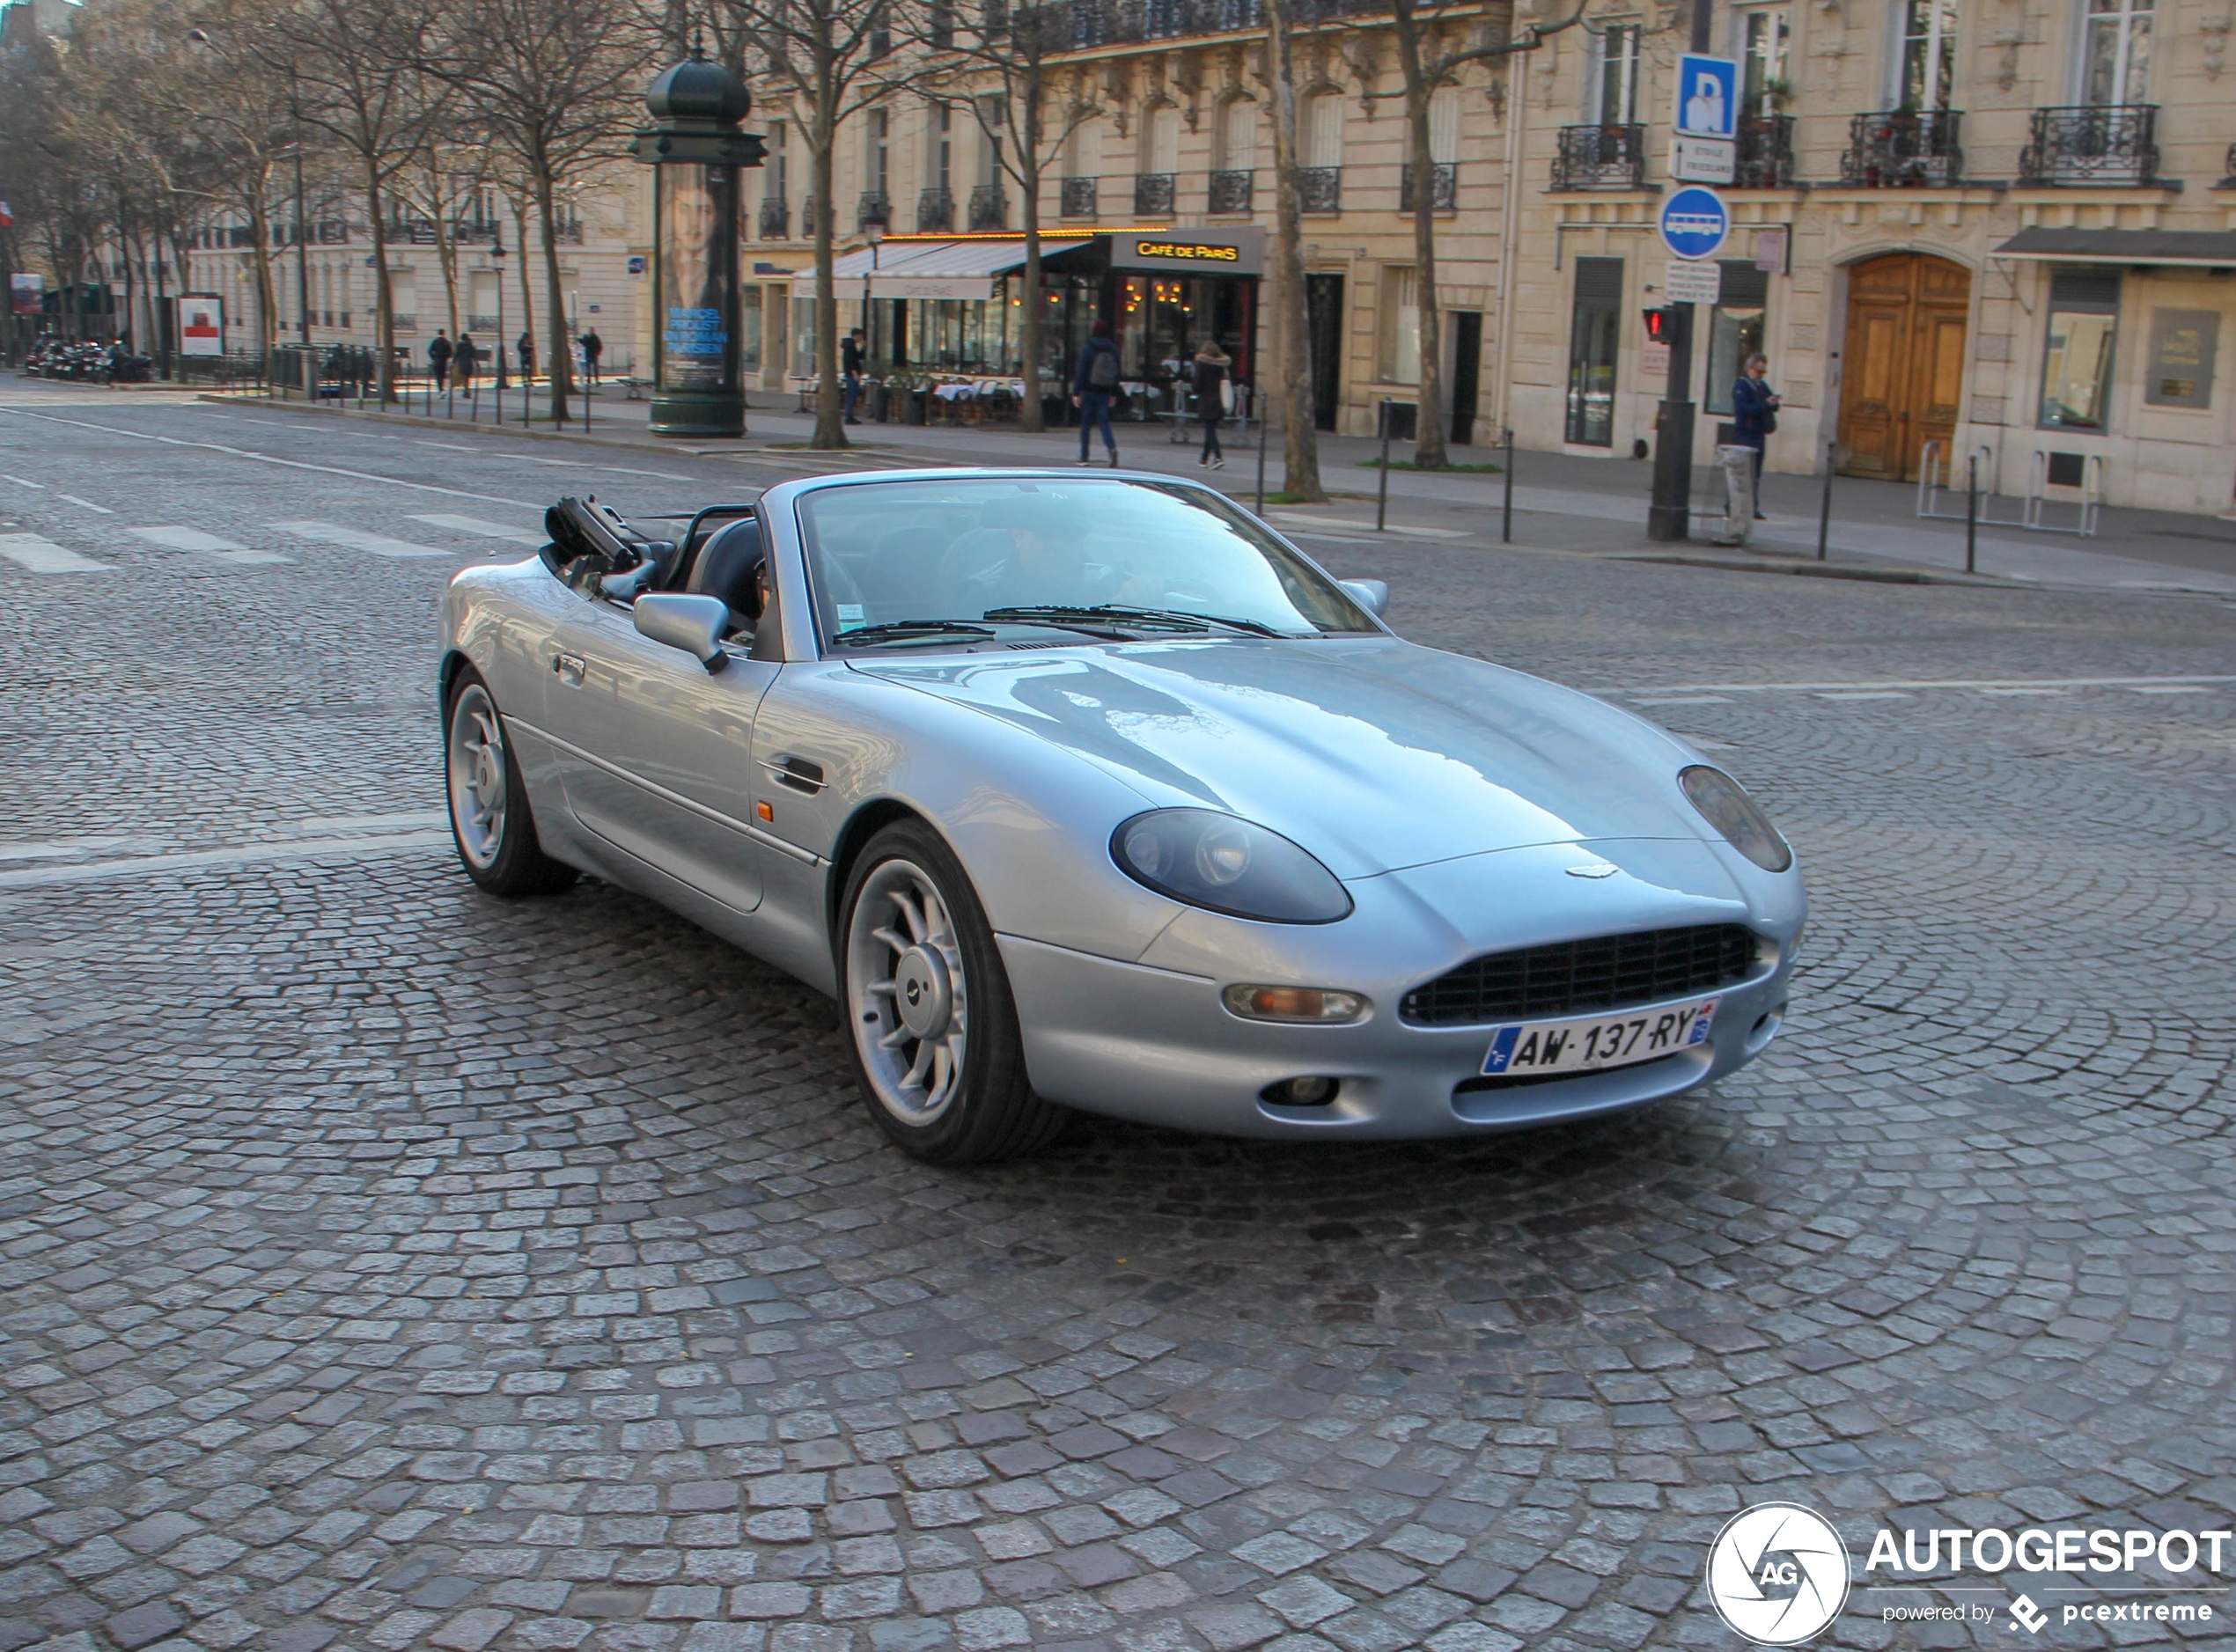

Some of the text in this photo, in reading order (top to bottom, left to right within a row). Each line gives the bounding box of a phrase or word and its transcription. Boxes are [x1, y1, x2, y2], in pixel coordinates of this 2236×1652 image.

[1137, 242, 1238, 261] CAFÉ DE PARIS
[670, 319, 720, 330] PROUST
[1512, 1007, 1697, 1067] AW-137-RY
[1493, 1054, 1505, 1065] F
